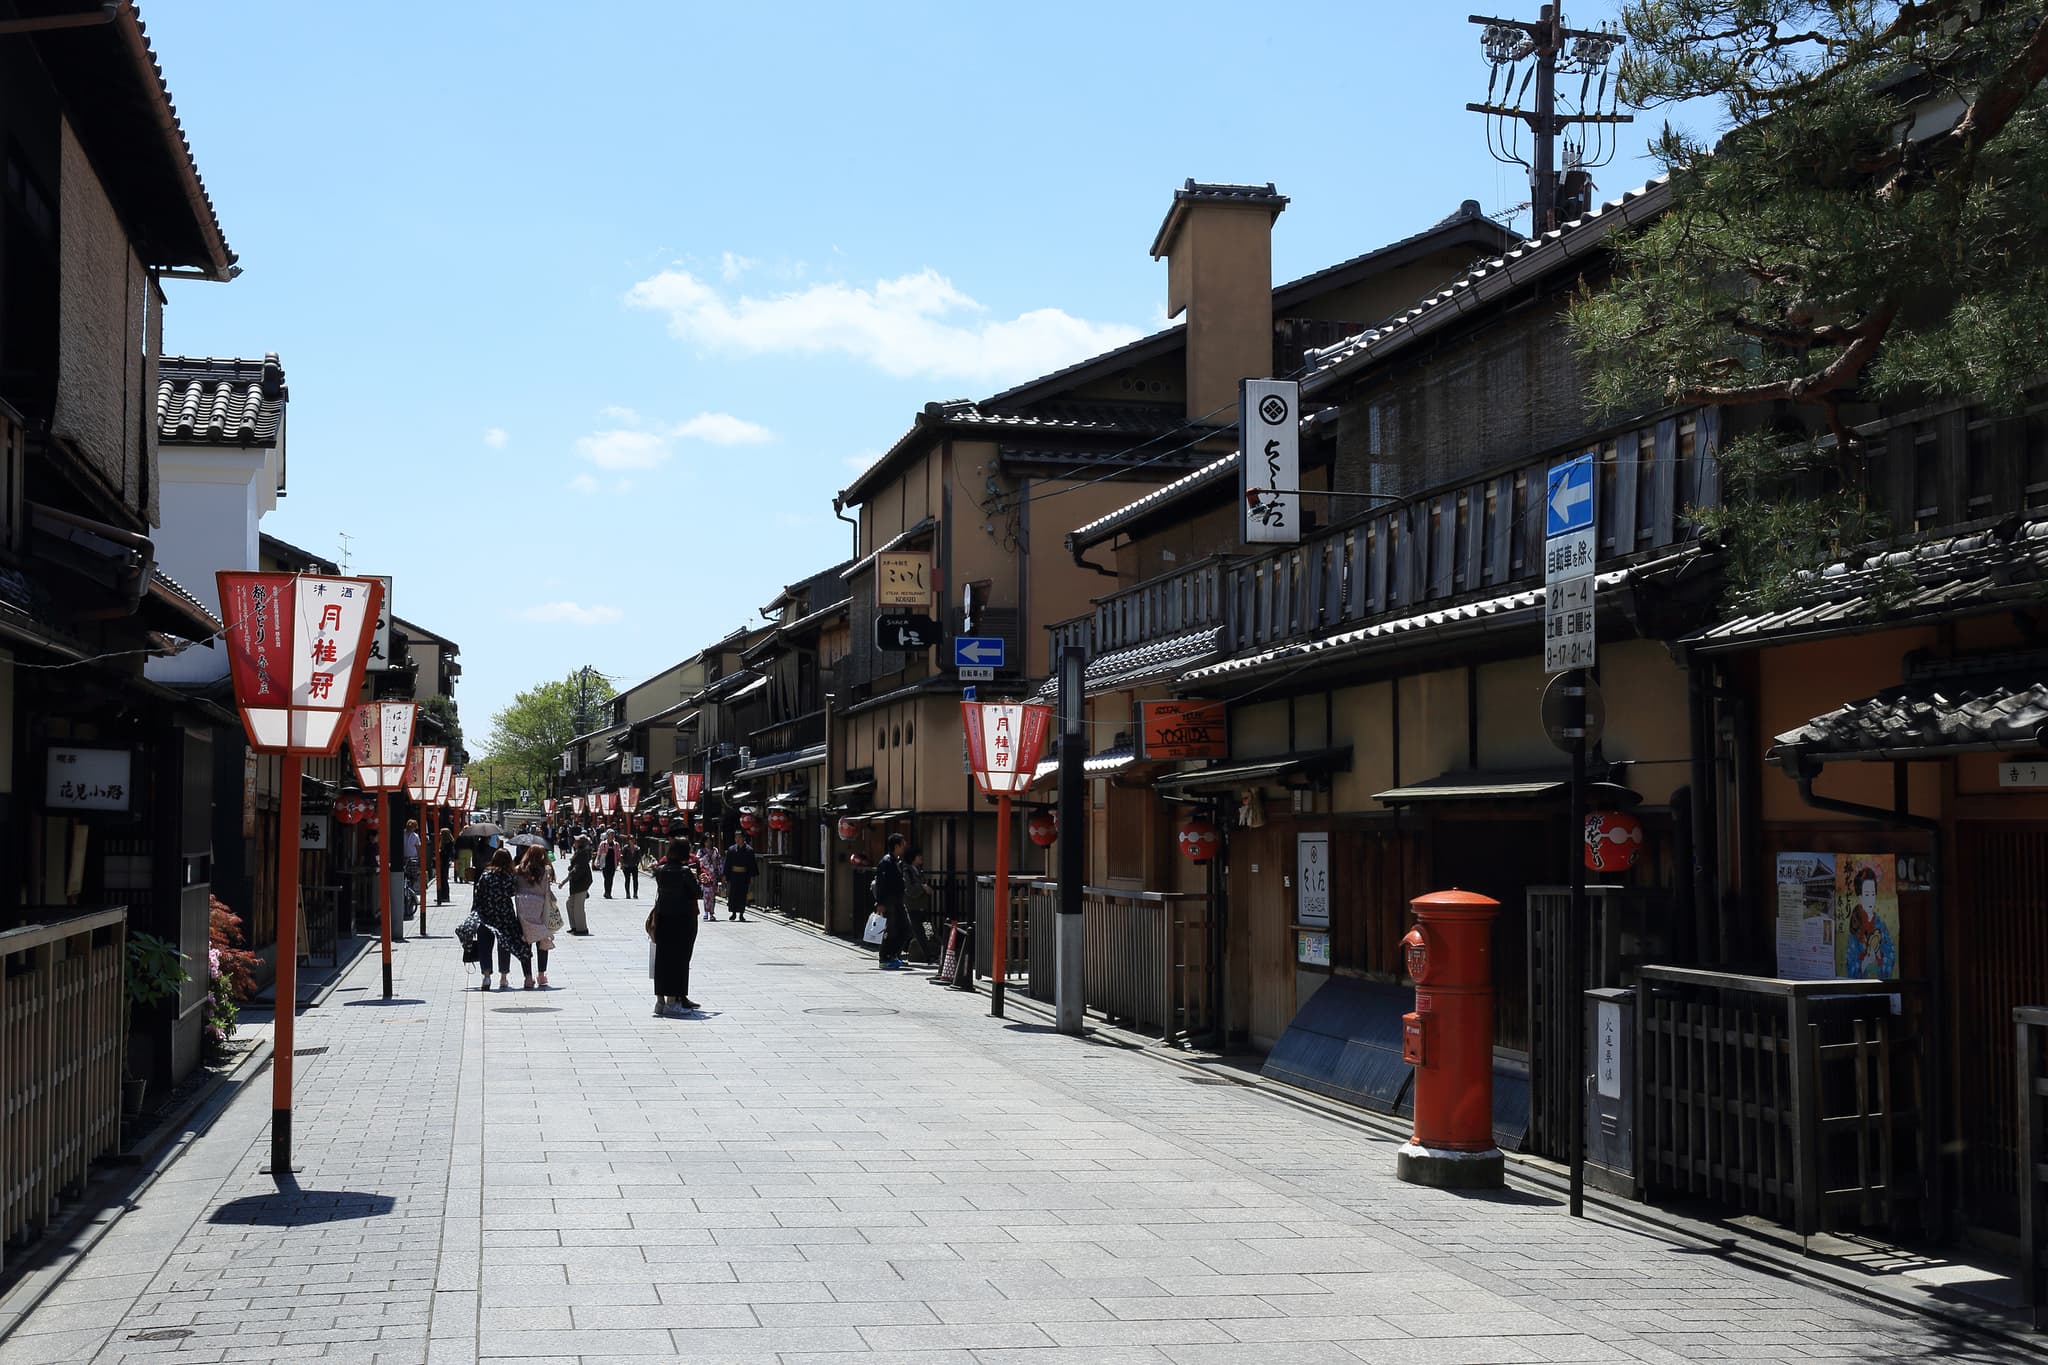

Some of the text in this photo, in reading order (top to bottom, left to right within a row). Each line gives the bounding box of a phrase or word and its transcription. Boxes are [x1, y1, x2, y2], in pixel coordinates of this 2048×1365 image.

[1547, 540, 1593, 575] 自転車を除く
[888, 562, 924, 589] こいし
[313, 583, 354, 598] 清酒
[898, 627, 925, 647] トミ
[308, 604, 342, 700] 月桂冠
[961, 669, 993, 678] 自転車を除く
[994, 716, 1010, 768] 月桂冠
[1155, 726, 1210, 745] YOSHIDA
[59, 780, 124, 802] 花見小路
[302, 822, 321, 842] 梅
